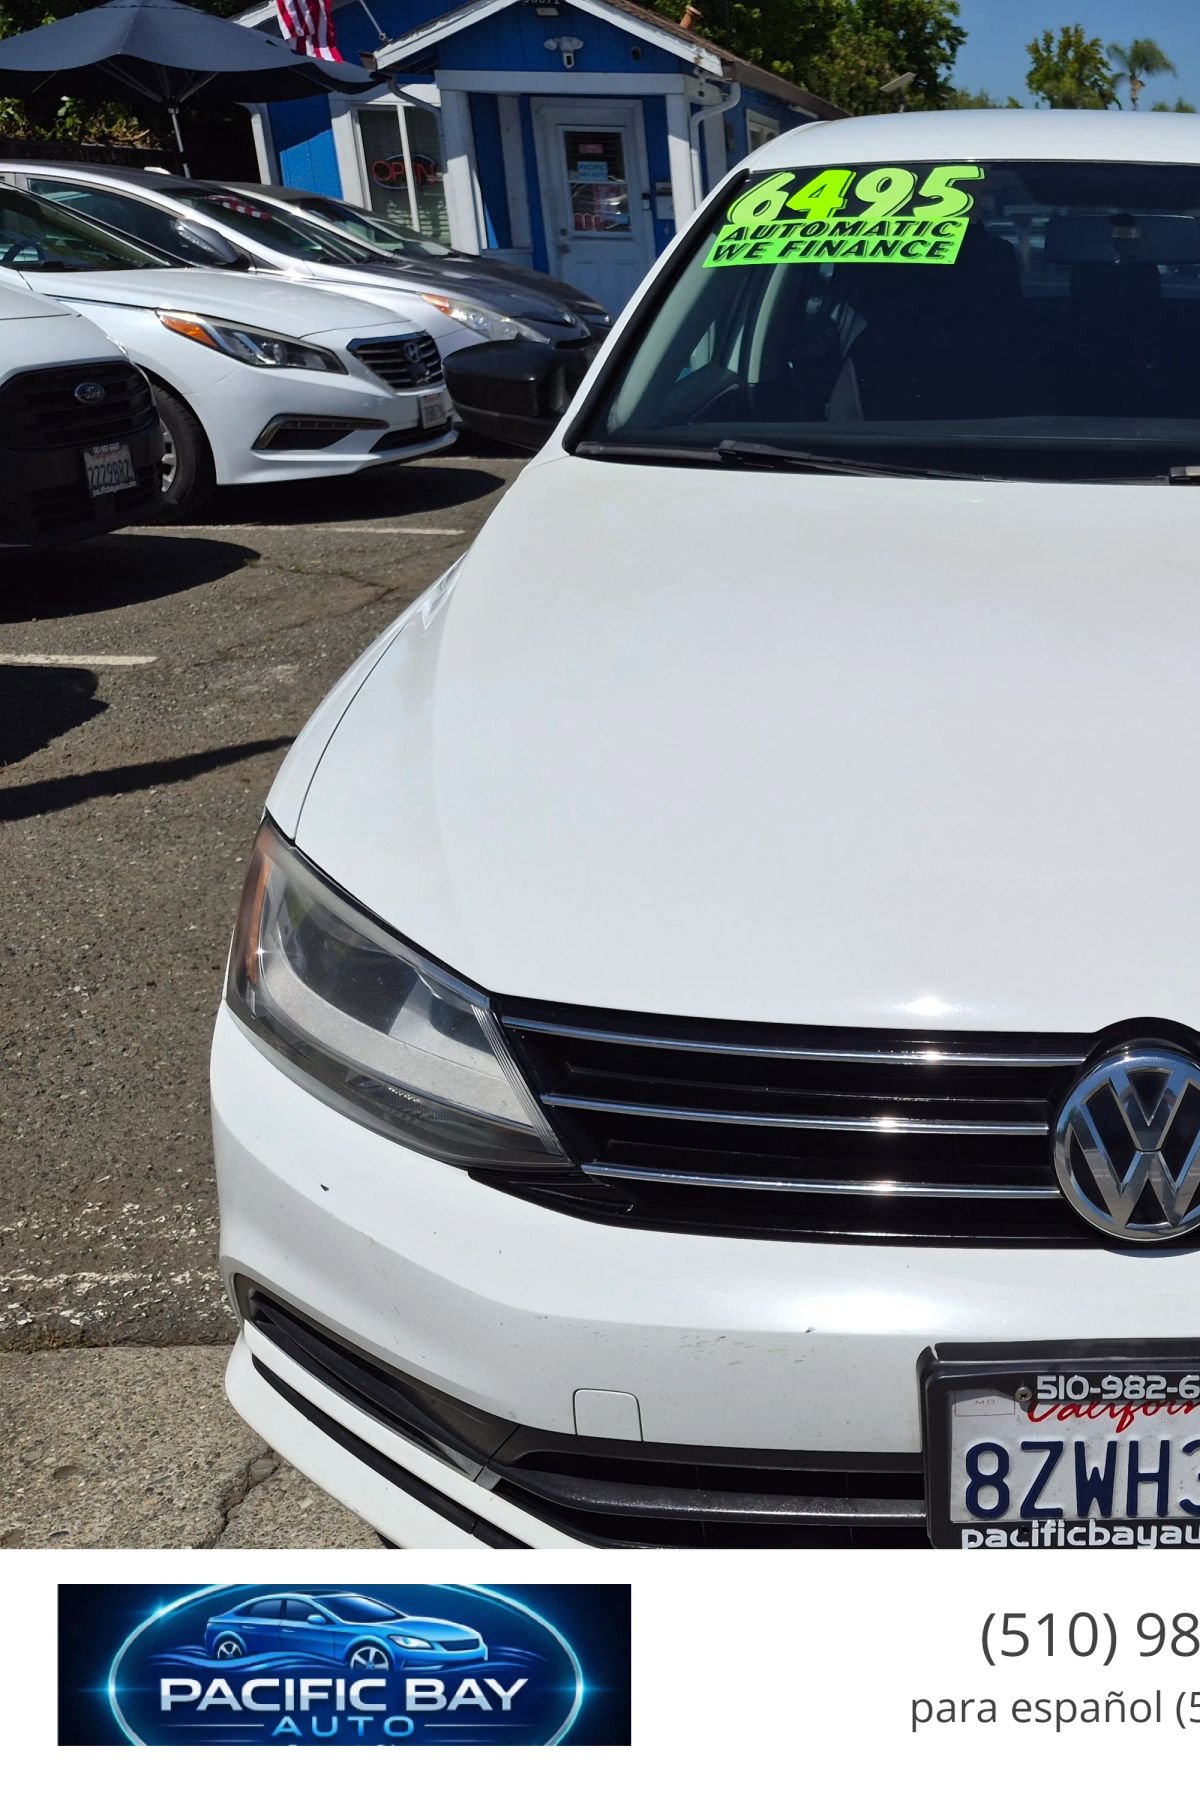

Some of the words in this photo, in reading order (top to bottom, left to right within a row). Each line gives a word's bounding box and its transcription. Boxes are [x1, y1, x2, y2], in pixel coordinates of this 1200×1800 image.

[372, 161, 435, 184] OPN
[727, 165, 985, 224] 6495
[721, 220, 959, 242] AUTOMATIC
[712, 242, 770, 261] WE
[778, 239, 953, 258] FINANCE
